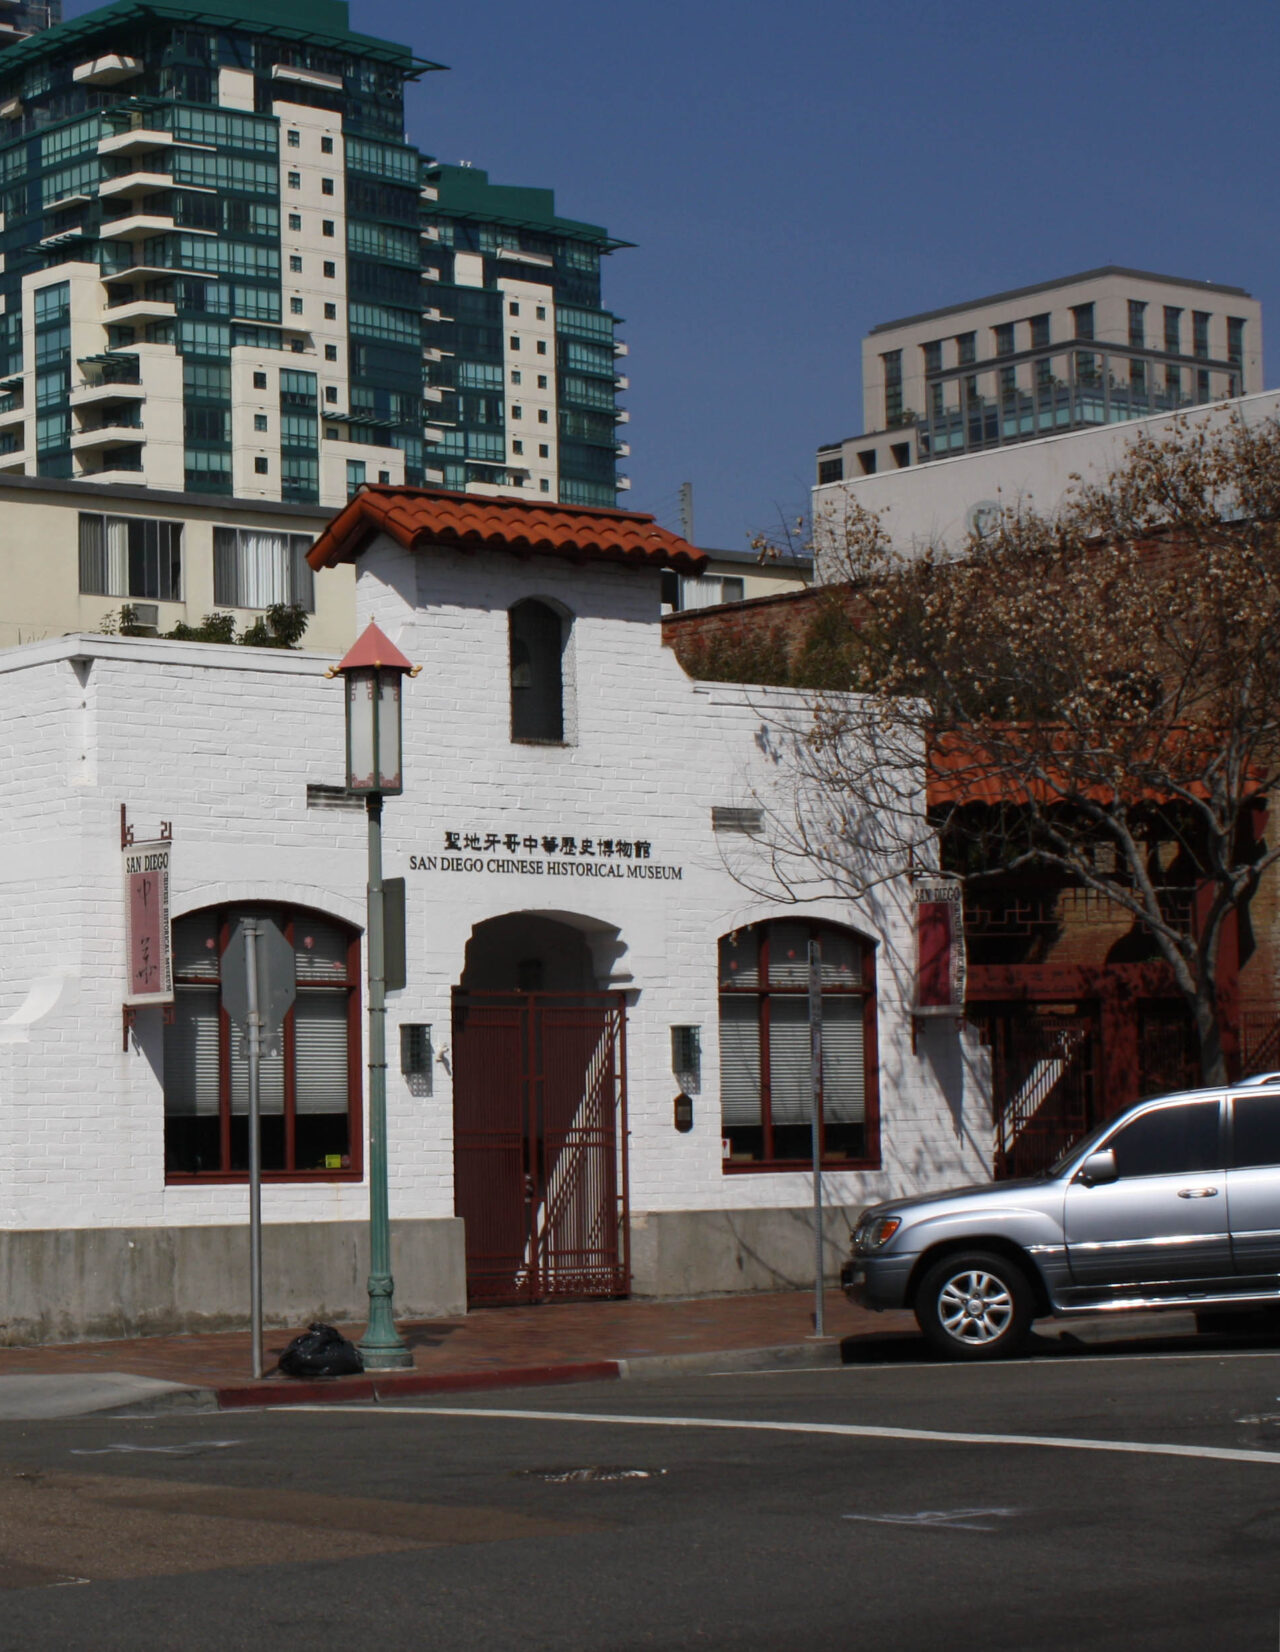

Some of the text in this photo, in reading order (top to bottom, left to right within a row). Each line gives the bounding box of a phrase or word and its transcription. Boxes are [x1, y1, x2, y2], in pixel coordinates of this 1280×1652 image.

[127, 852, 169, 873] SAN DIEGO
[410, 855, 683, 880] SAN DIEGO CHINESE HISTORICAL MUSEUM
[915, 886, 961, 902] SAN DIEGO
